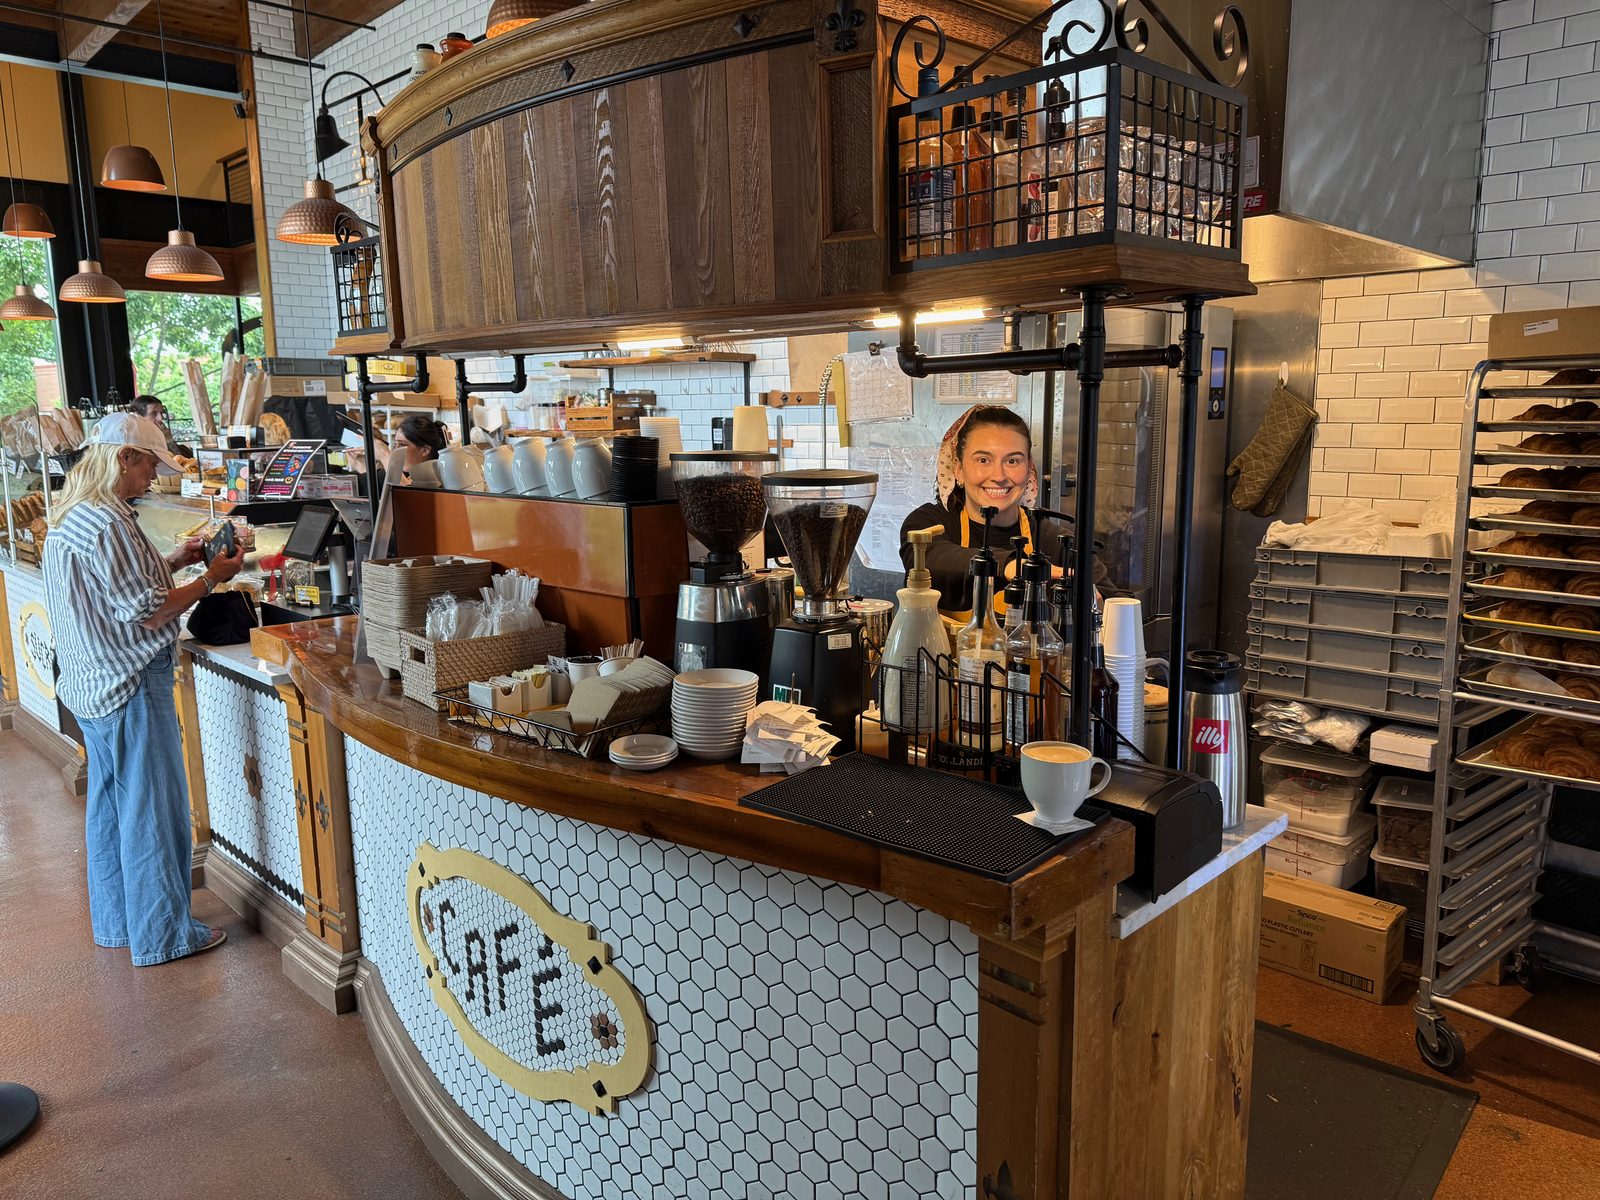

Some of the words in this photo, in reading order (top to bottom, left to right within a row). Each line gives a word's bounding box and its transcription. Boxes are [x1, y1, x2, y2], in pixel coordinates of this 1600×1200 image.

[1196, 726, 1224, 749] illy
[1287, 914, 1327, 933] Reliance
[1297, 909, 1317, 921] Sysco
[1267, 919, 1289, 930] PLASTIC
[1289, 926, 1314, 937] CUTLERY
[439, 898, 566, 1057] CAFÉ
